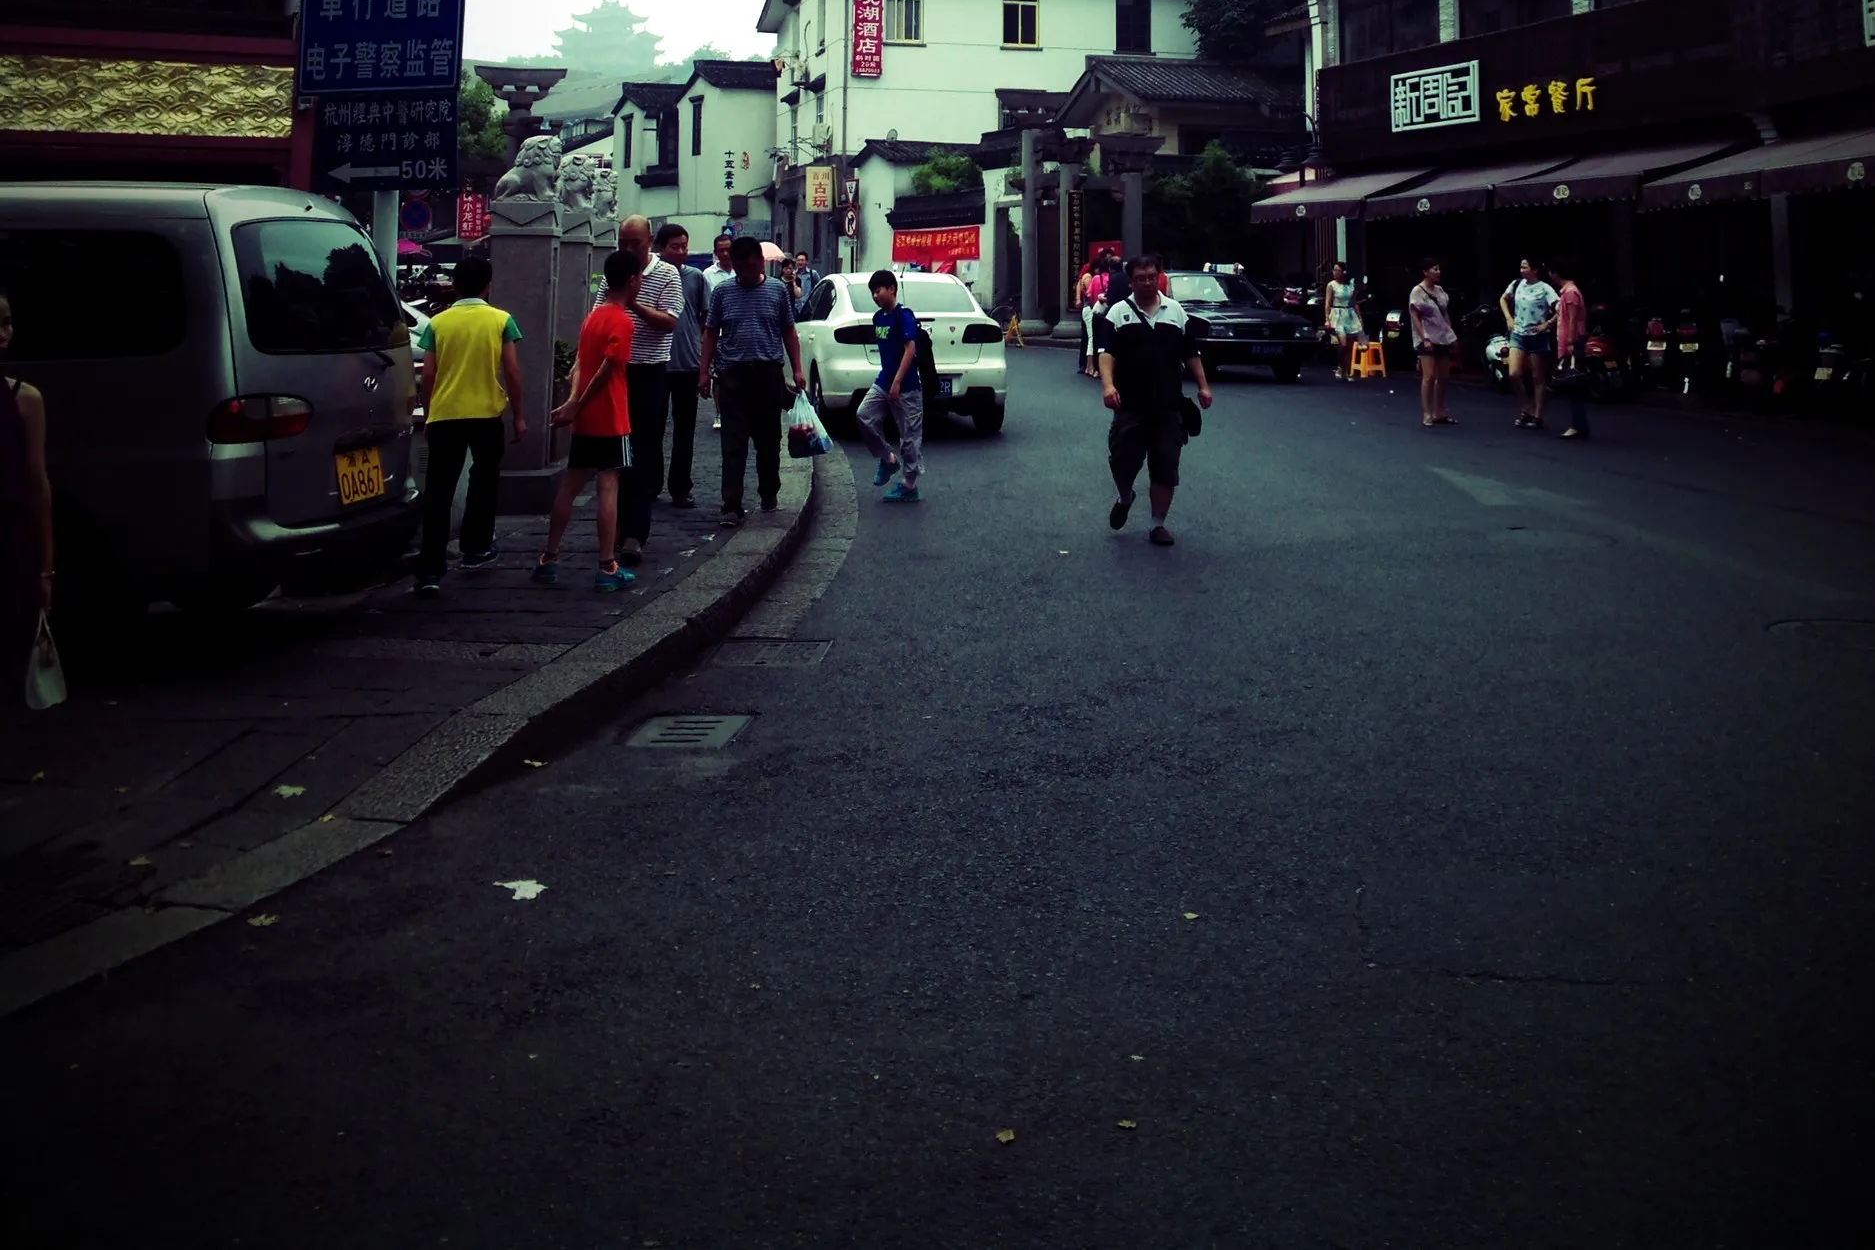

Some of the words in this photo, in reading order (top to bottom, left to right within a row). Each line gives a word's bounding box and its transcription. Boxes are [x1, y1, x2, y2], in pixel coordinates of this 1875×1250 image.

[306, 38, 453, 81] 电子警察监管
[401, 157, 448, 180] 50米
[812, 182, 828, 208] 古玩
[341, 464, 380, 500] 0A867
